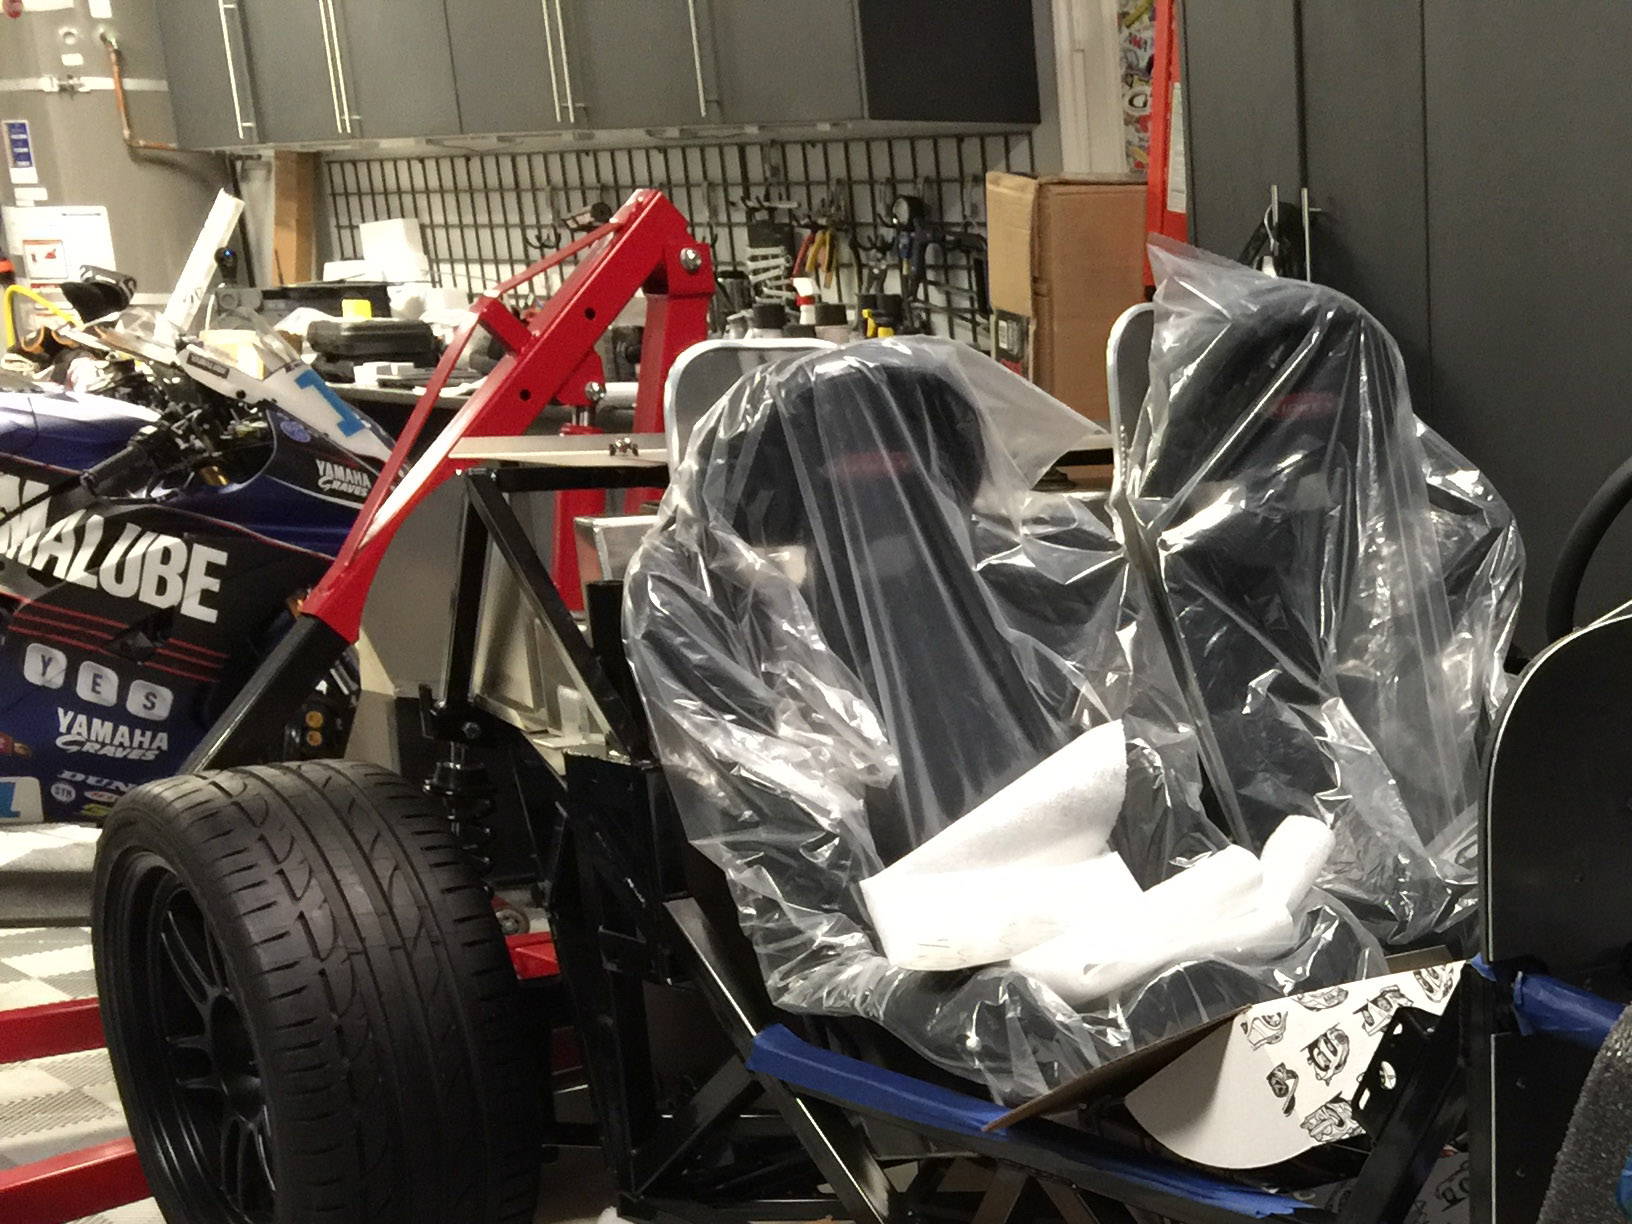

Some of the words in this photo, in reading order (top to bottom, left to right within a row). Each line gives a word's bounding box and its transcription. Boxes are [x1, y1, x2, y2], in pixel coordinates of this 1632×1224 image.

[295, 369, 365, 437] 1
[315, 458, 371, 488] YAMAHA
[318, 476, 369, 497] GRAVES
[57, 706, 169, 752] YAMAHA
[55, 733, 160, 761] GRAVES
[57, 770, 138, 793] DUN
